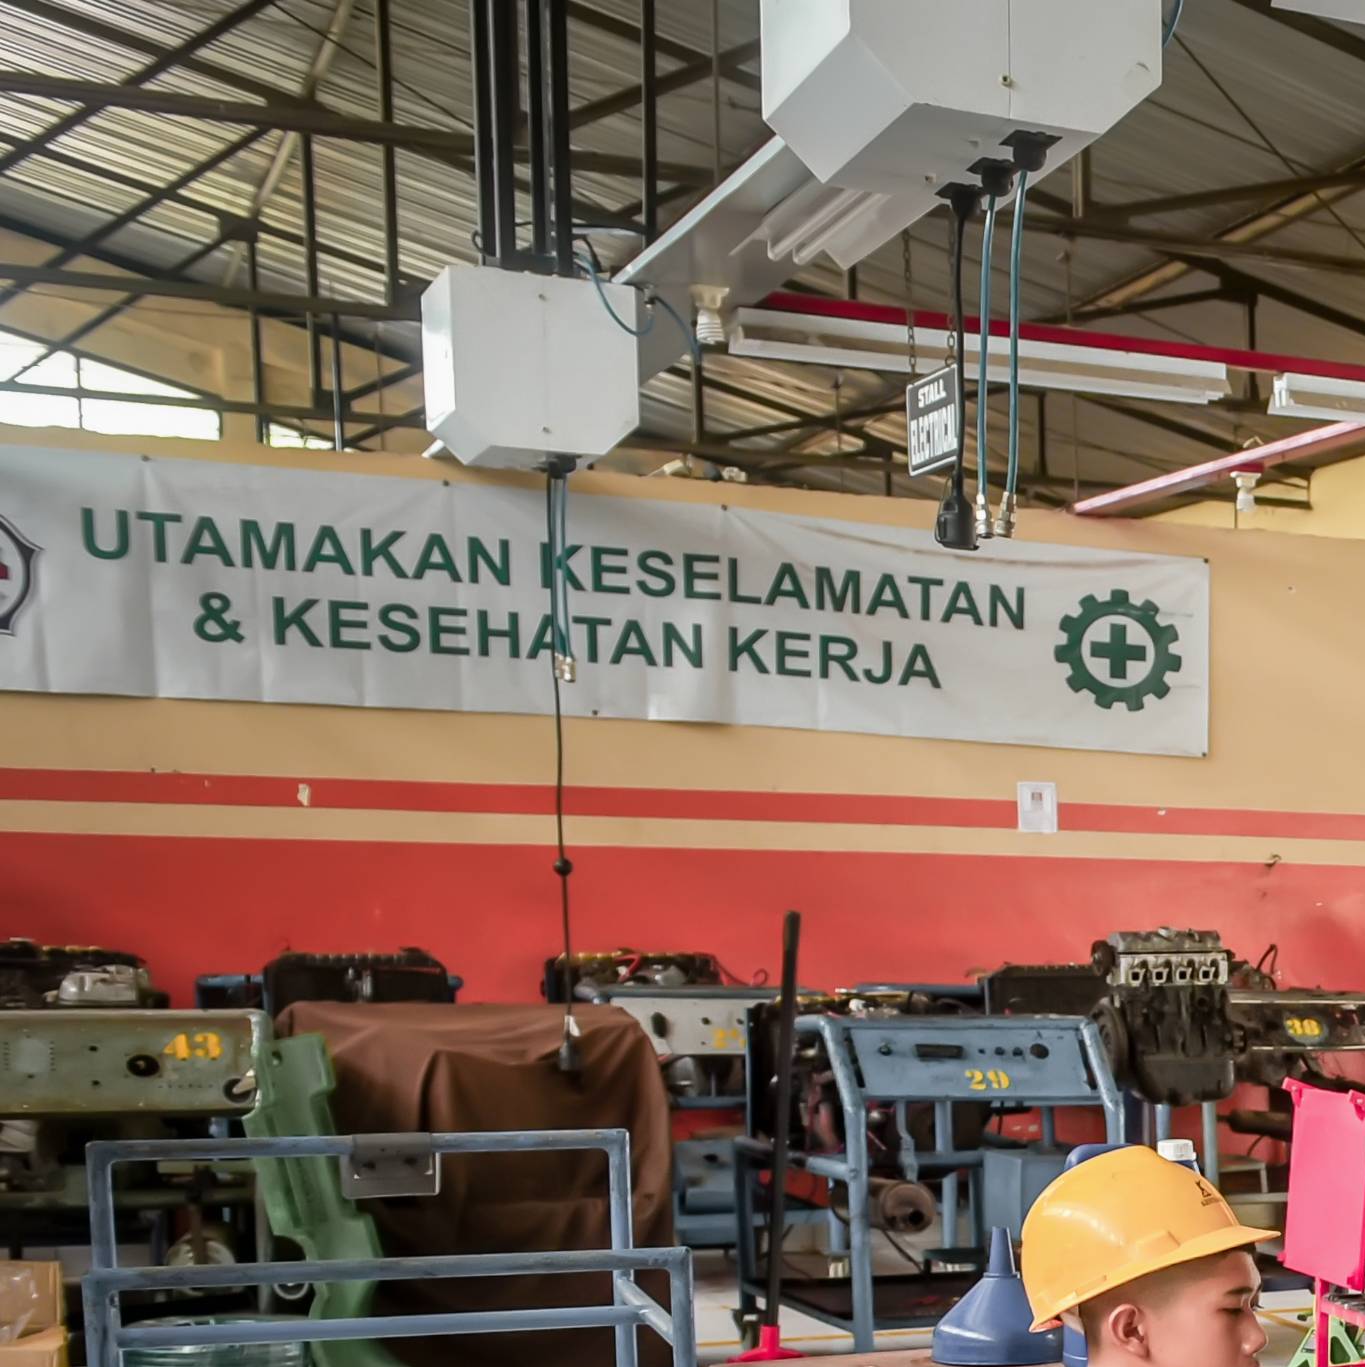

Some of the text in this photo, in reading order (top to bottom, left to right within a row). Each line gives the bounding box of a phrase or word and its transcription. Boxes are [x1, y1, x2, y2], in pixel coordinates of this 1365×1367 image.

[918, 378, 947, 408] STALL
[910, 403, 957, 466] ELECTRICAL
[81, 507, 1026, 630] UTAMAKAN KESELAMATAN
[193, 592, 942, 689] & KESEHATAN KERJA
[163, 1033, 223, 1060] 43
